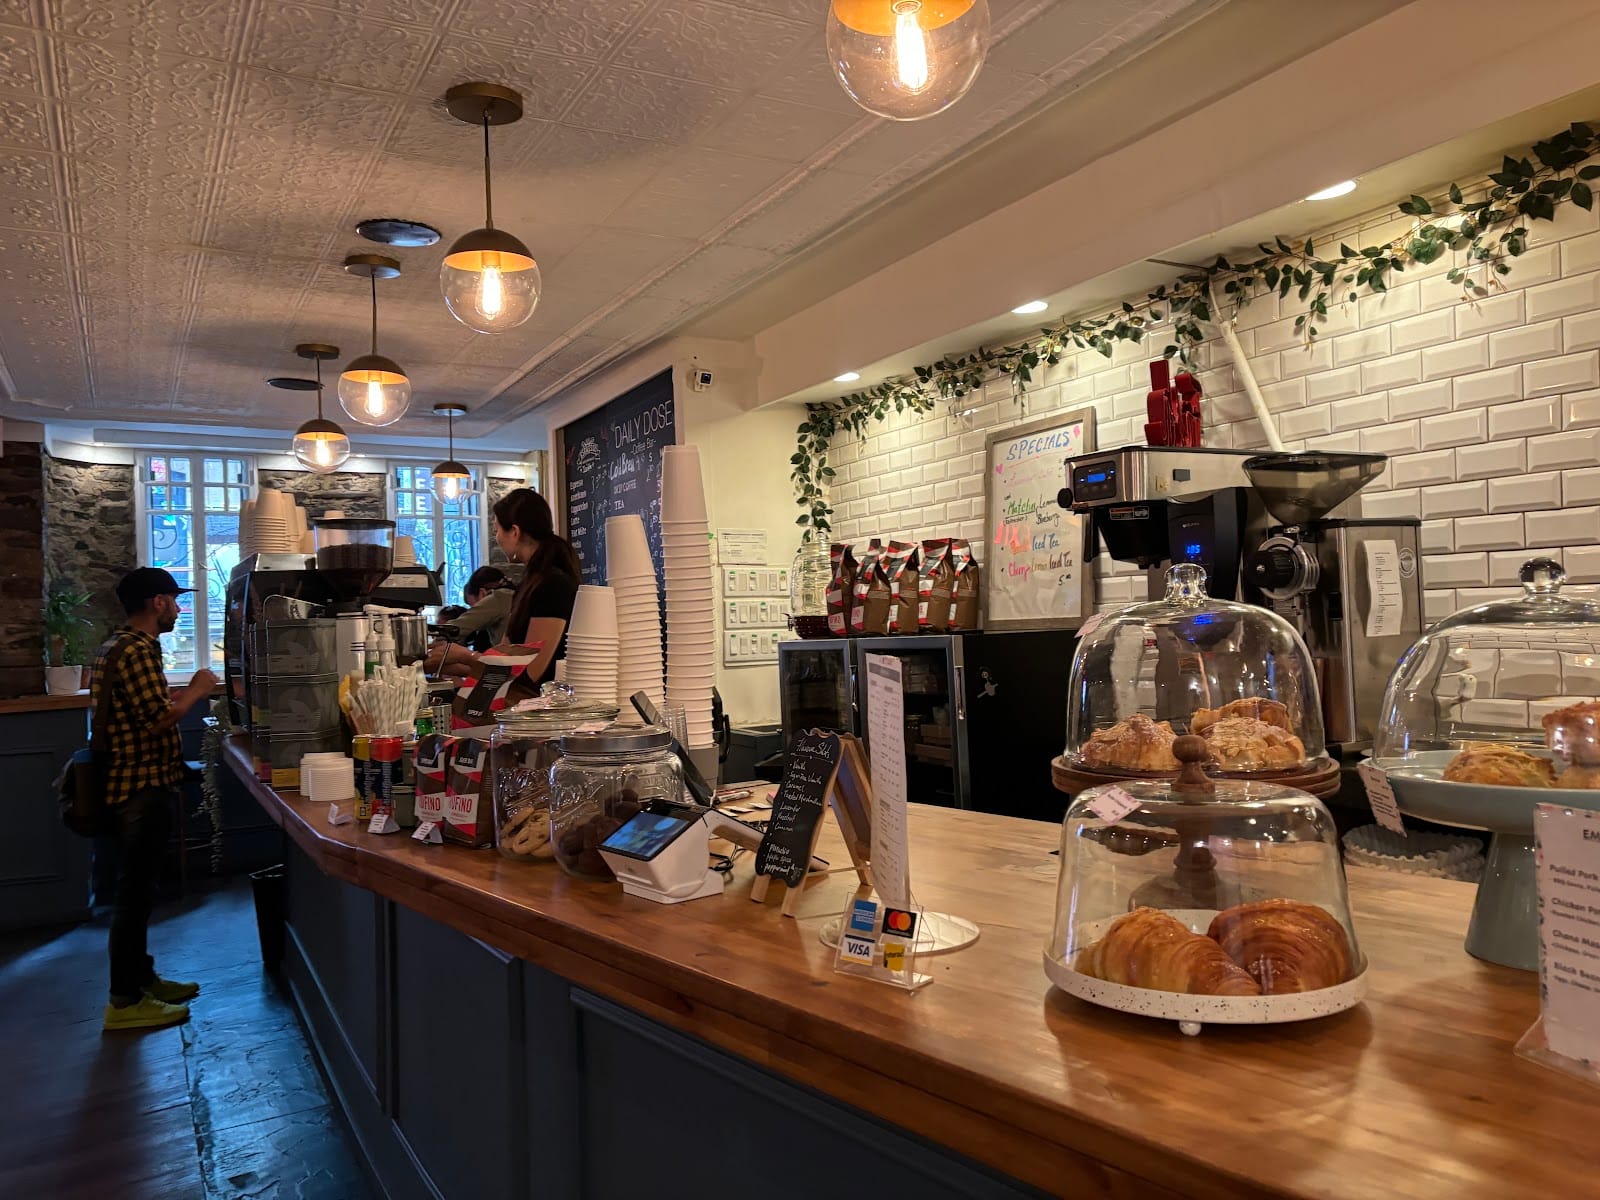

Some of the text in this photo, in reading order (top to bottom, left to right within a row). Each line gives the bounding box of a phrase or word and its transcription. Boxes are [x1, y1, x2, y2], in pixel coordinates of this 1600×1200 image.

[614, 415, 641, 449] DAILY
[643, 399, 673, 436] DOSE
[1006, 431, 1071, 461] SPECIALS
[614, 500, 625, 511] TEA
[1032, 534, 1047, 551] Iced
[1048, 533, 1060, 550] Tea
[1551, 897, 1586, 911] Chicken
[847, 942, 870, 957] VISA
